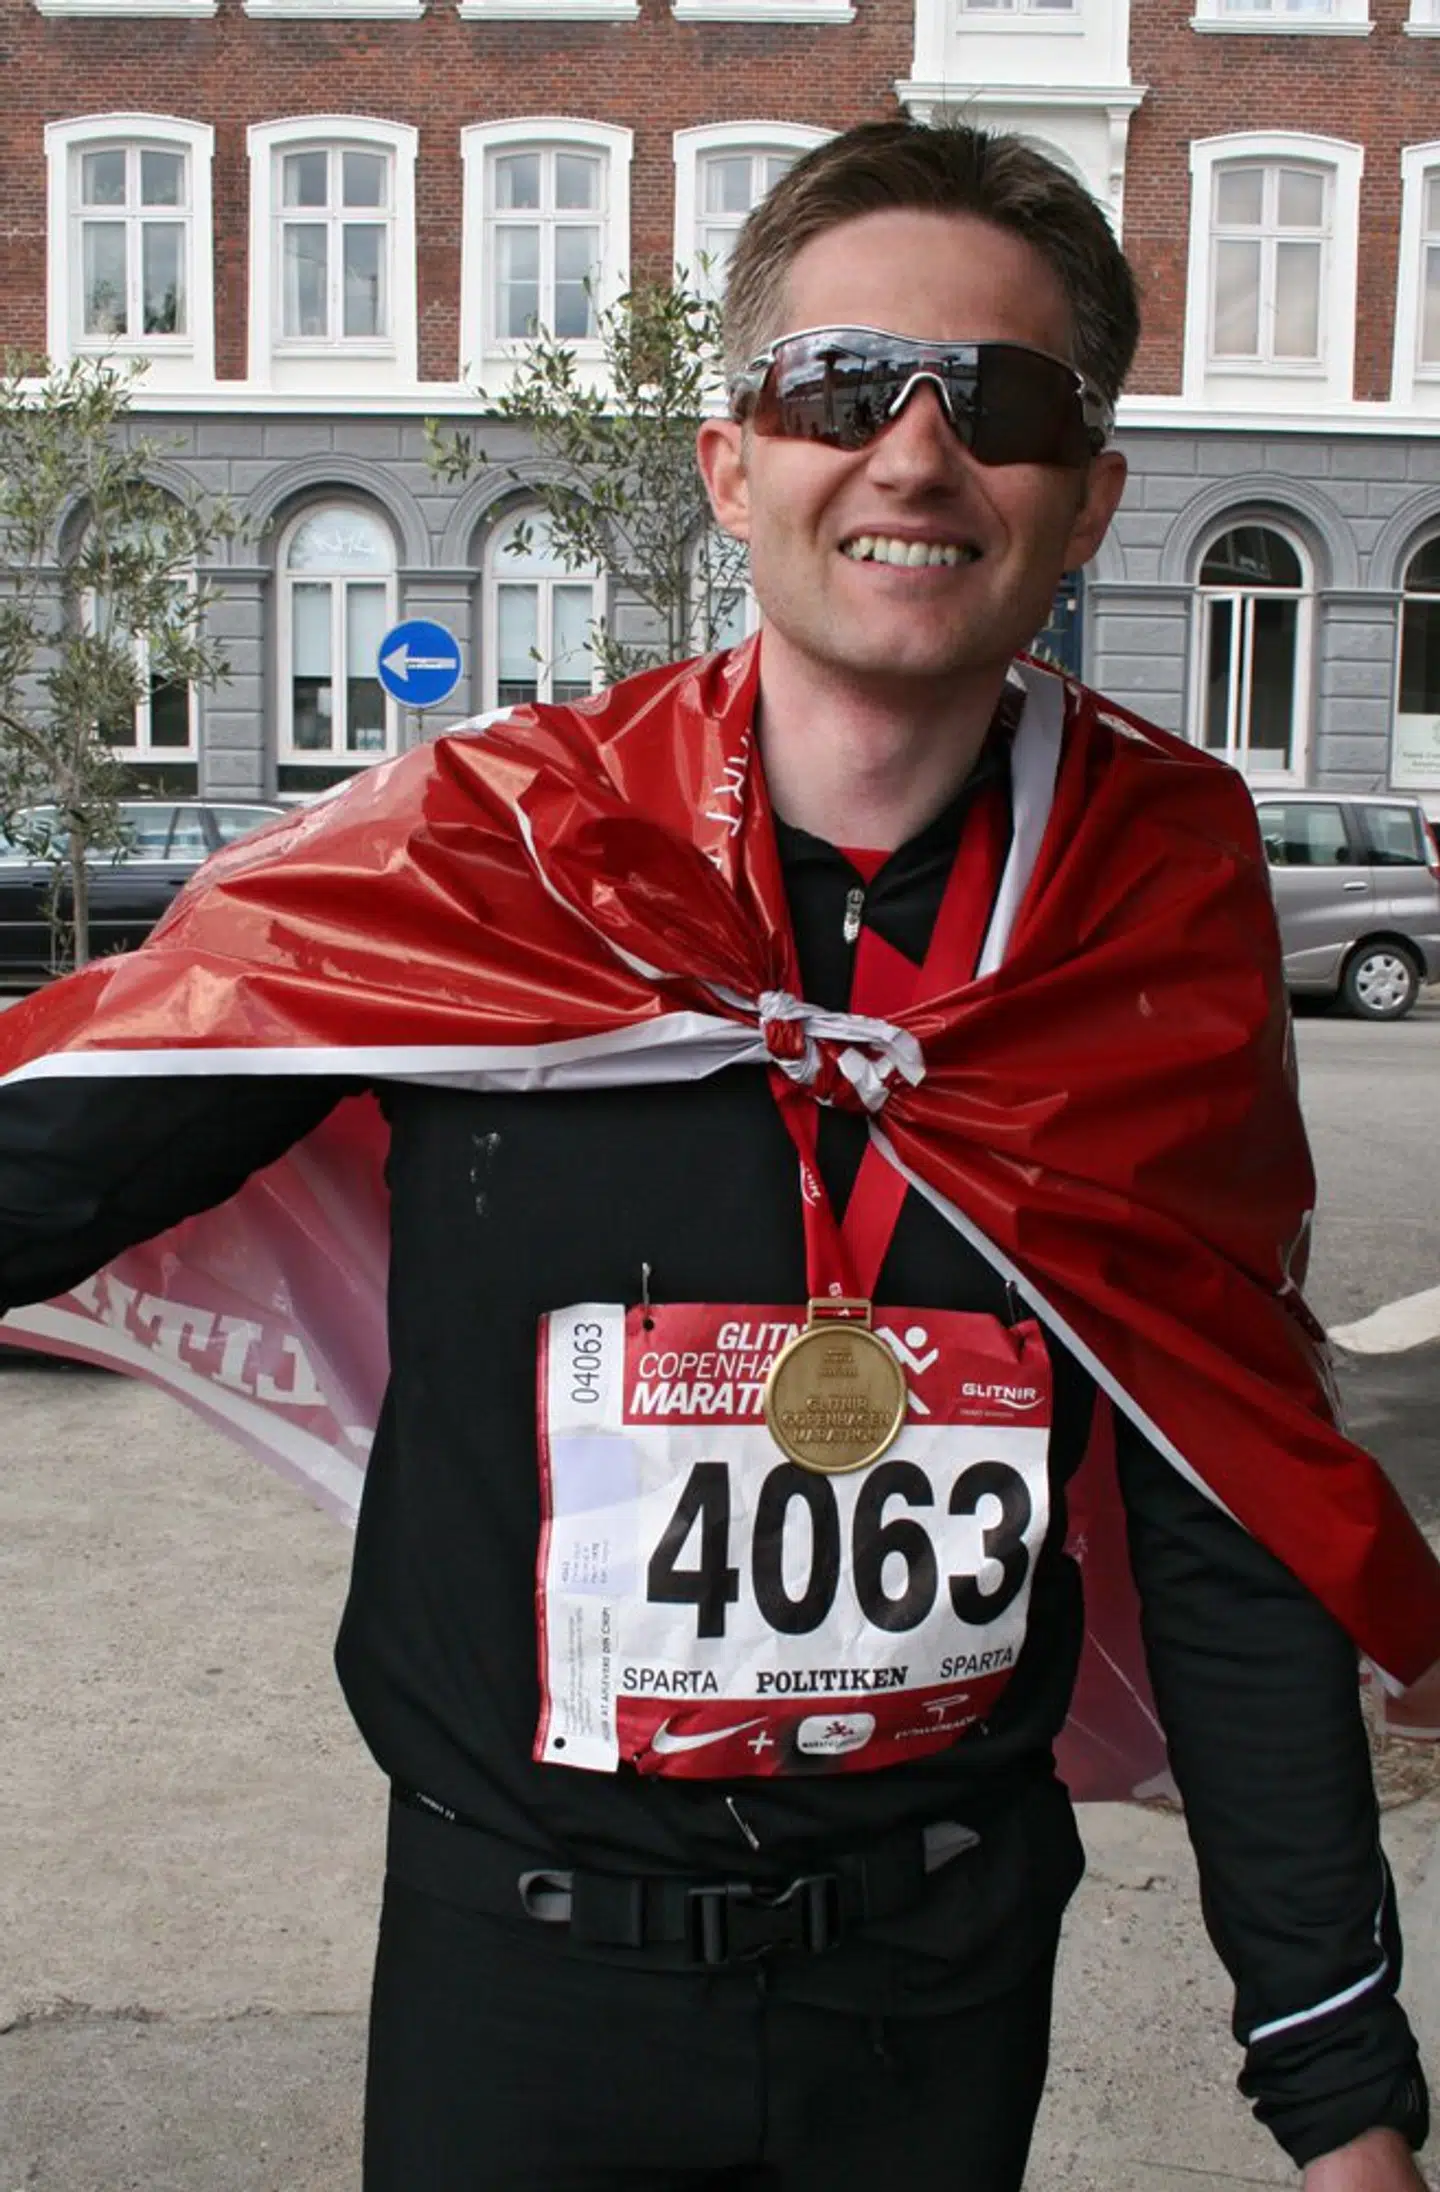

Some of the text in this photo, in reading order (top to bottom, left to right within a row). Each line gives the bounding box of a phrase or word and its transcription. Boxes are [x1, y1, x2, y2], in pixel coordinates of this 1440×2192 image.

[717, 1322, 809, 1351] GLITN
[571, 1323, 602, 1403] 04063
[639, 1352, 775, 1379] COPENHA
[629, 1382, 765, 1415] MARAT
[962, 1383, 1036, 1400] GLITNIR
[646, 1460, 1032, 1639] 4063
[940, 1648, 1013, 1679] SPARTA
[623, 1668, 718, 1693] SPARTA
[756, 1667, 909, 1694] POLITIKEN
